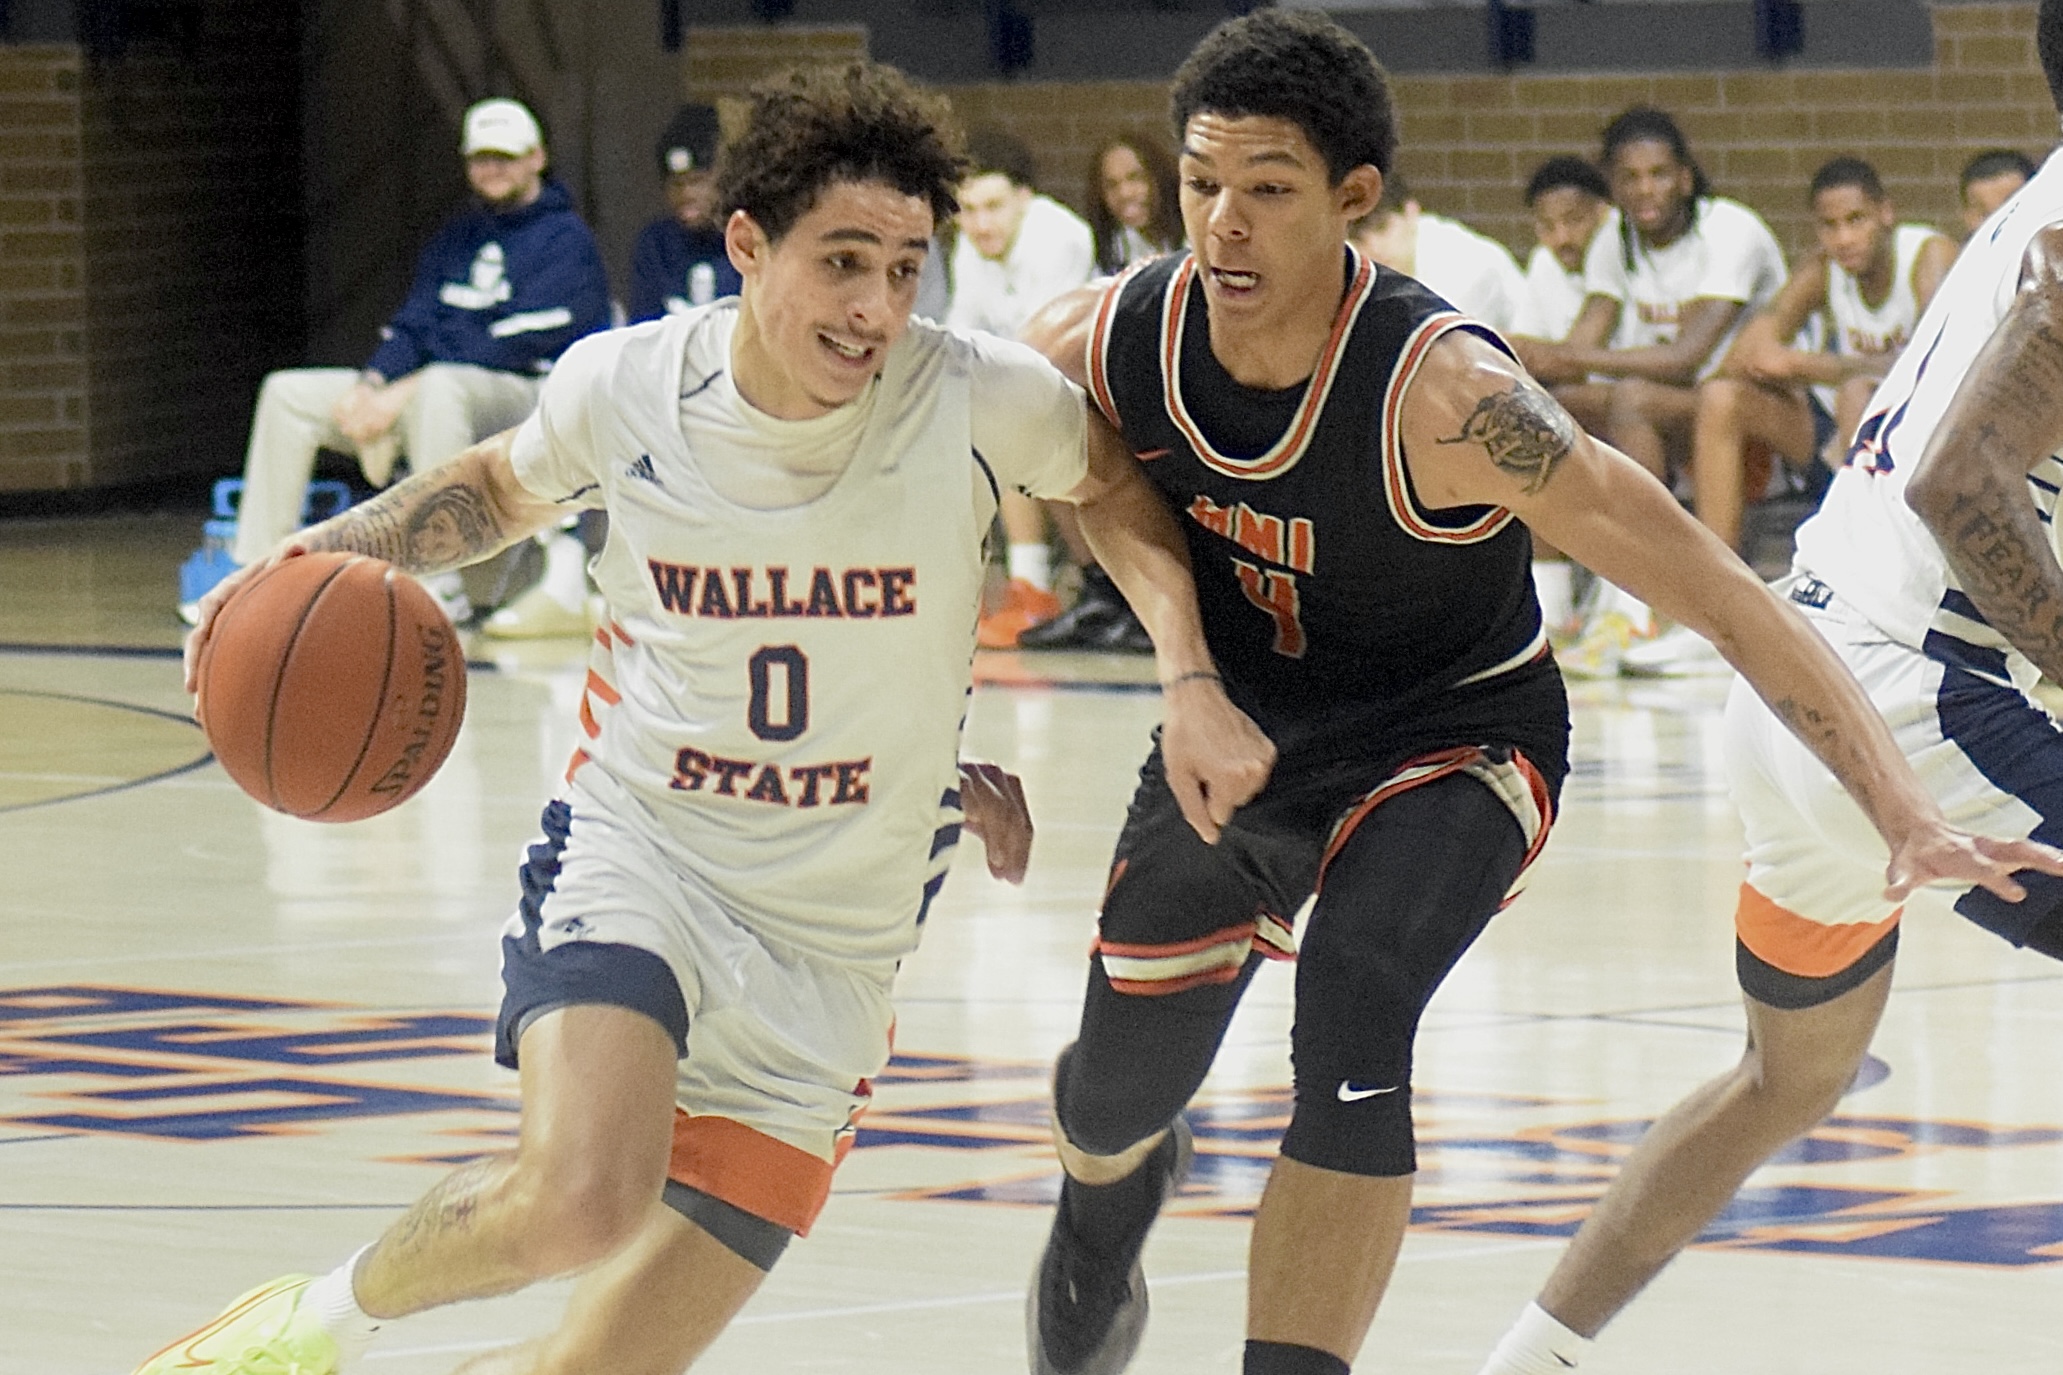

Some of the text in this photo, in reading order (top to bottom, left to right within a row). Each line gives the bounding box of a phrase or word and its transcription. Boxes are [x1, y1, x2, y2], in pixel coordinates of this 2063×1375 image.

[647, 555, 917, 619] WALLACE
[1230, 556, 1308, 660] 4
[747, 643, 809, 742] 0
[668, 746, 873, 808] STATE
